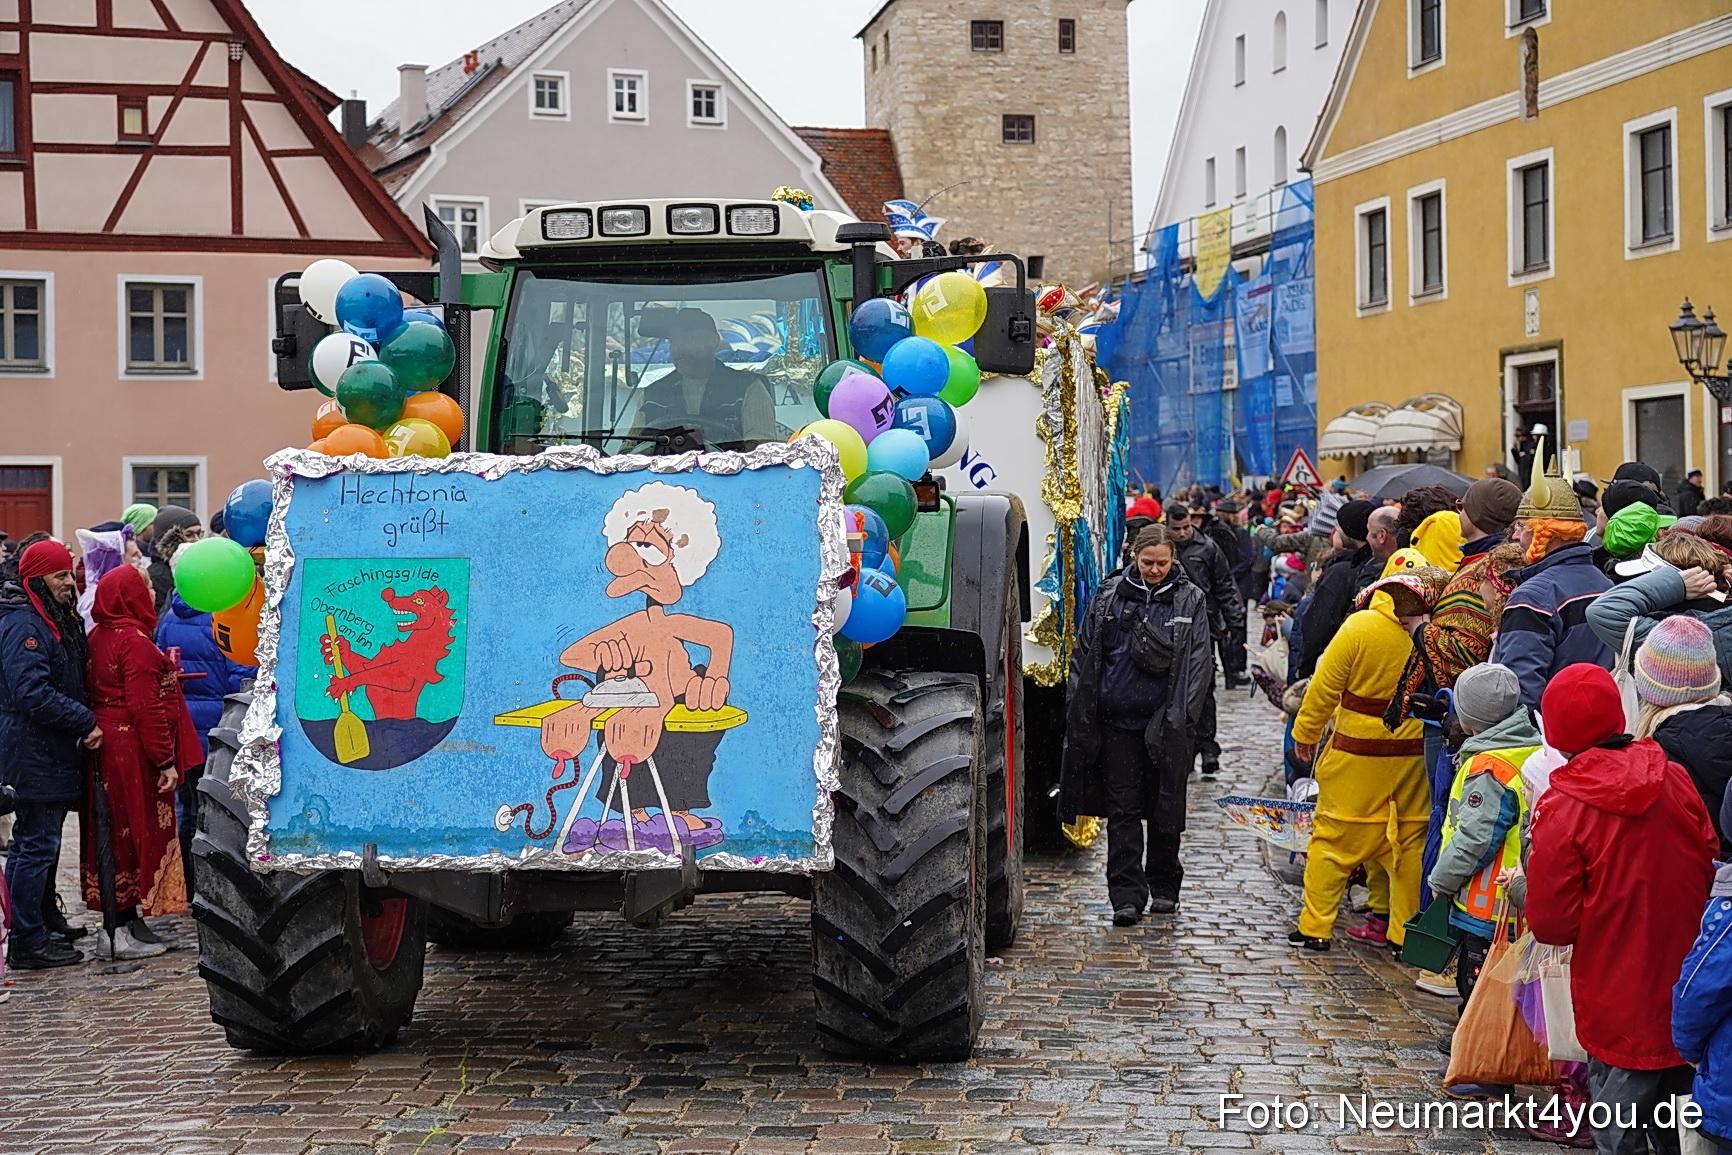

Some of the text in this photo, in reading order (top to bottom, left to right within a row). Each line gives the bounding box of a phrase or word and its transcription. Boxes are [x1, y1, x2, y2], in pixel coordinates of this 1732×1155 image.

[340, 472, 468, 505] Hechtonia
[382, 507, 450, 548] grüßt
[323, 565, 440, 598] Faschingsgilde
[310, 597, 375, 636] Obernberg
[338, 623, 373, 650] am Inn
